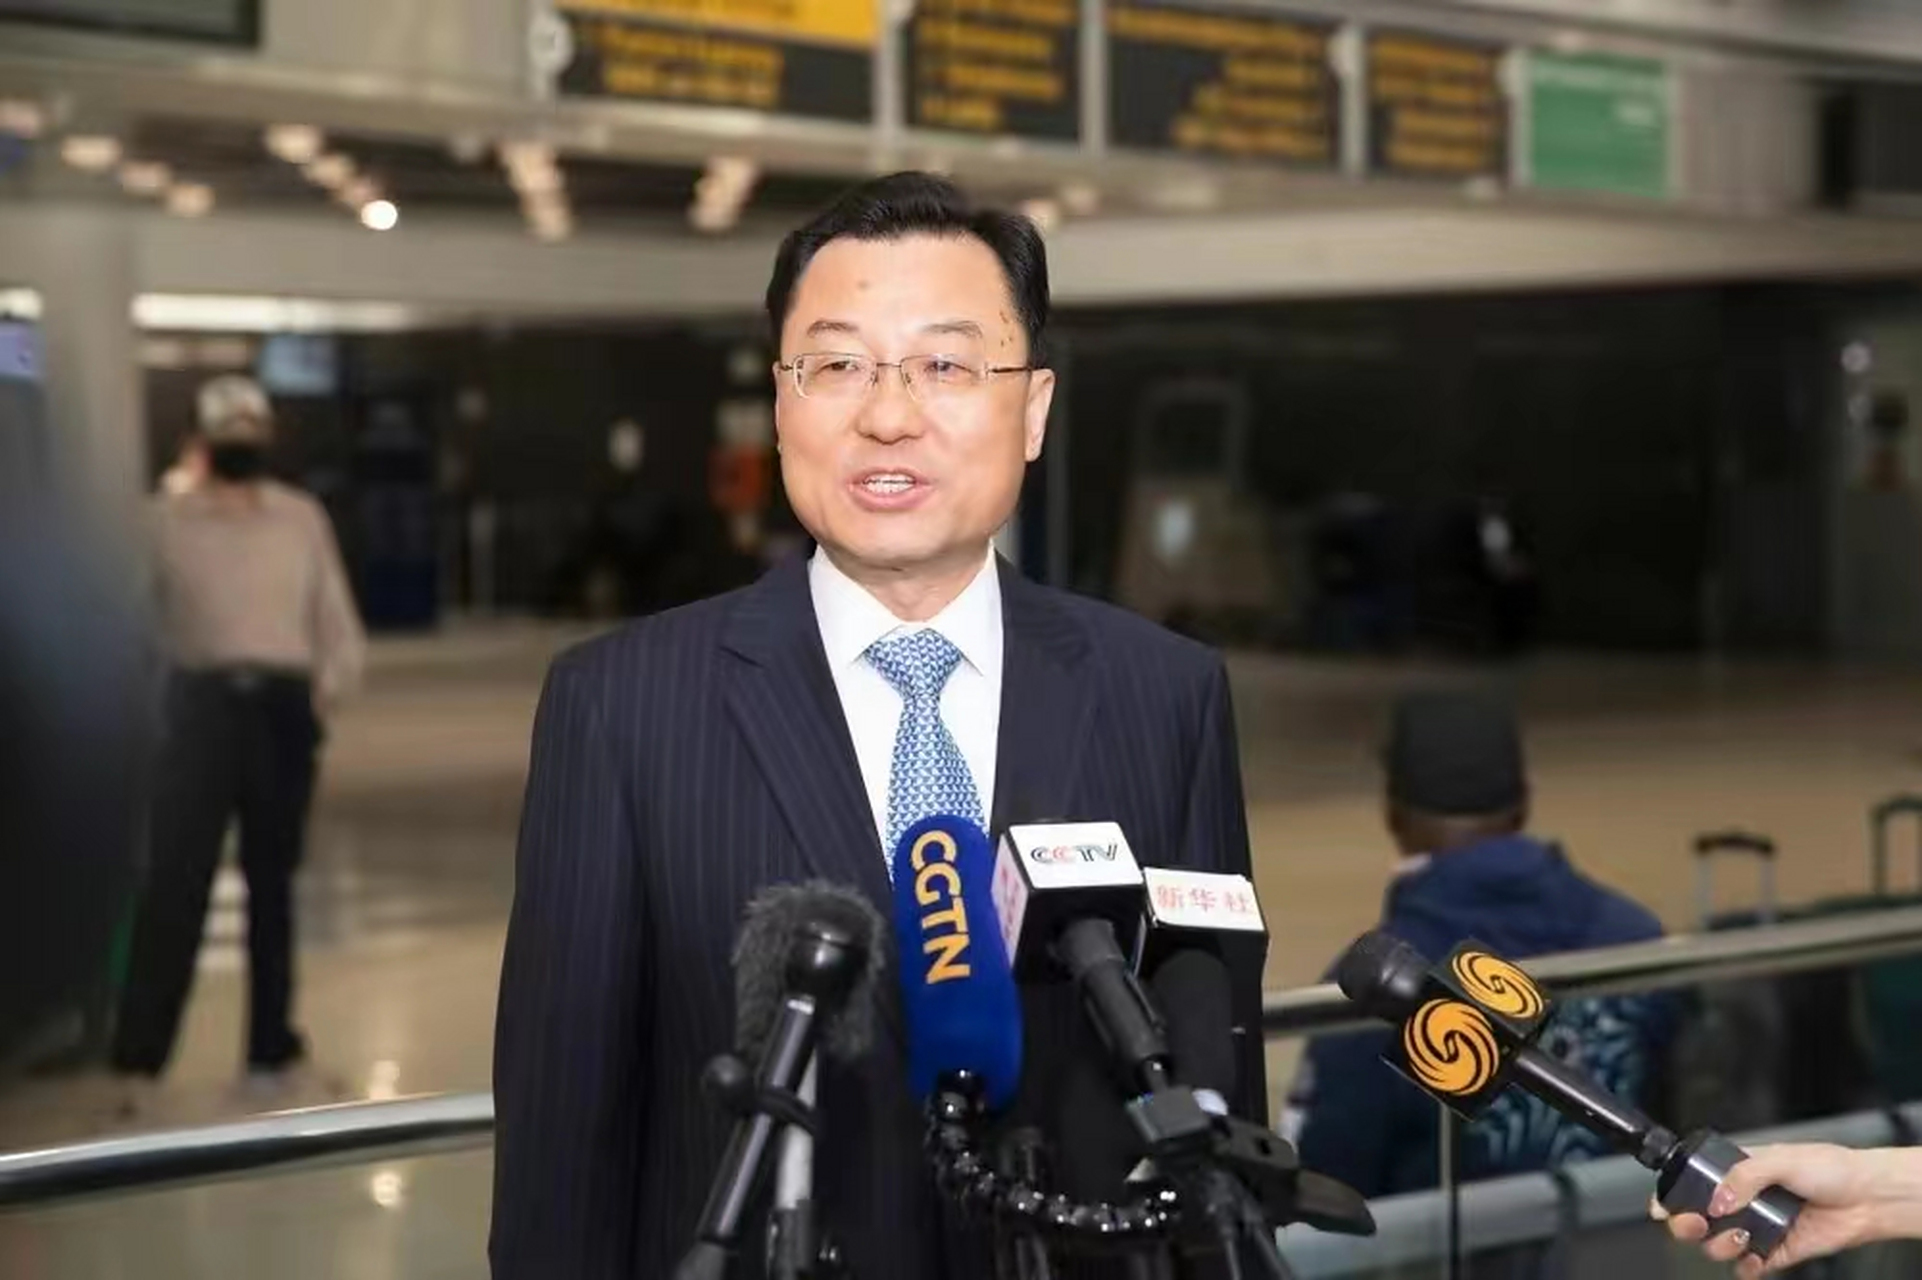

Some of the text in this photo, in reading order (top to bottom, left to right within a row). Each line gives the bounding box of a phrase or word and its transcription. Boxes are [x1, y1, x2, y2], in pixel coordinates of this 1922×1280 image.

[1030, 844, 1119, 864] CCTV
[911, 829, 971, 985] CGTN
[1157, 884, 1256, 914] 新华社
